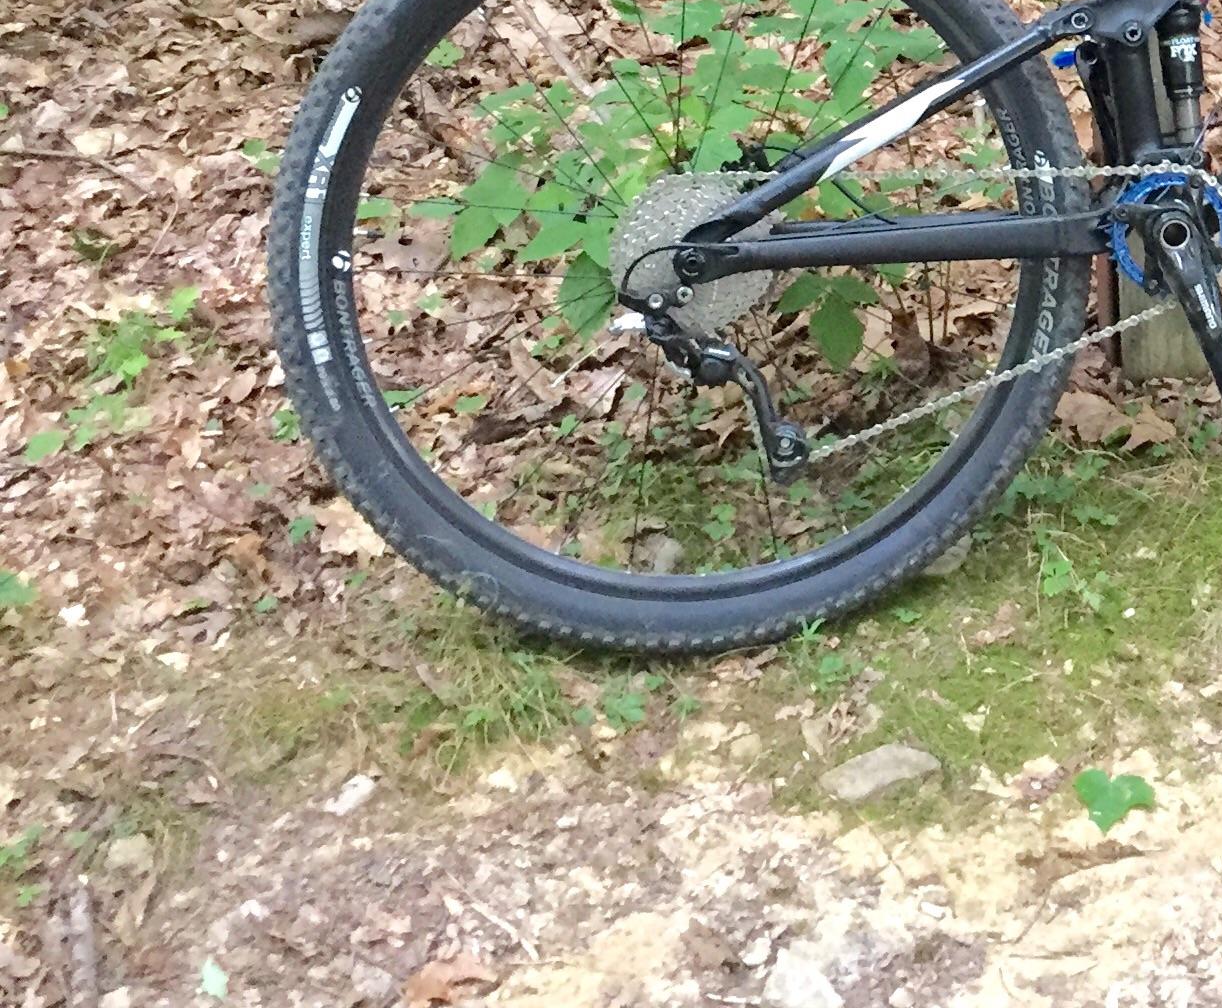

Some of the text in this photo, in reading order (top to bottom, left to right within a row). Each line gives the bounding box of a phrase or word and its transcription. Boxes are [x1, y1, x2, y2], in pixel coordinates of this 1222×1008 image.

[1170, 43, 1198, 63] FOX
[300, 214, 313, 261] expert
[333, 278, 378, 409] BONTRAGER
